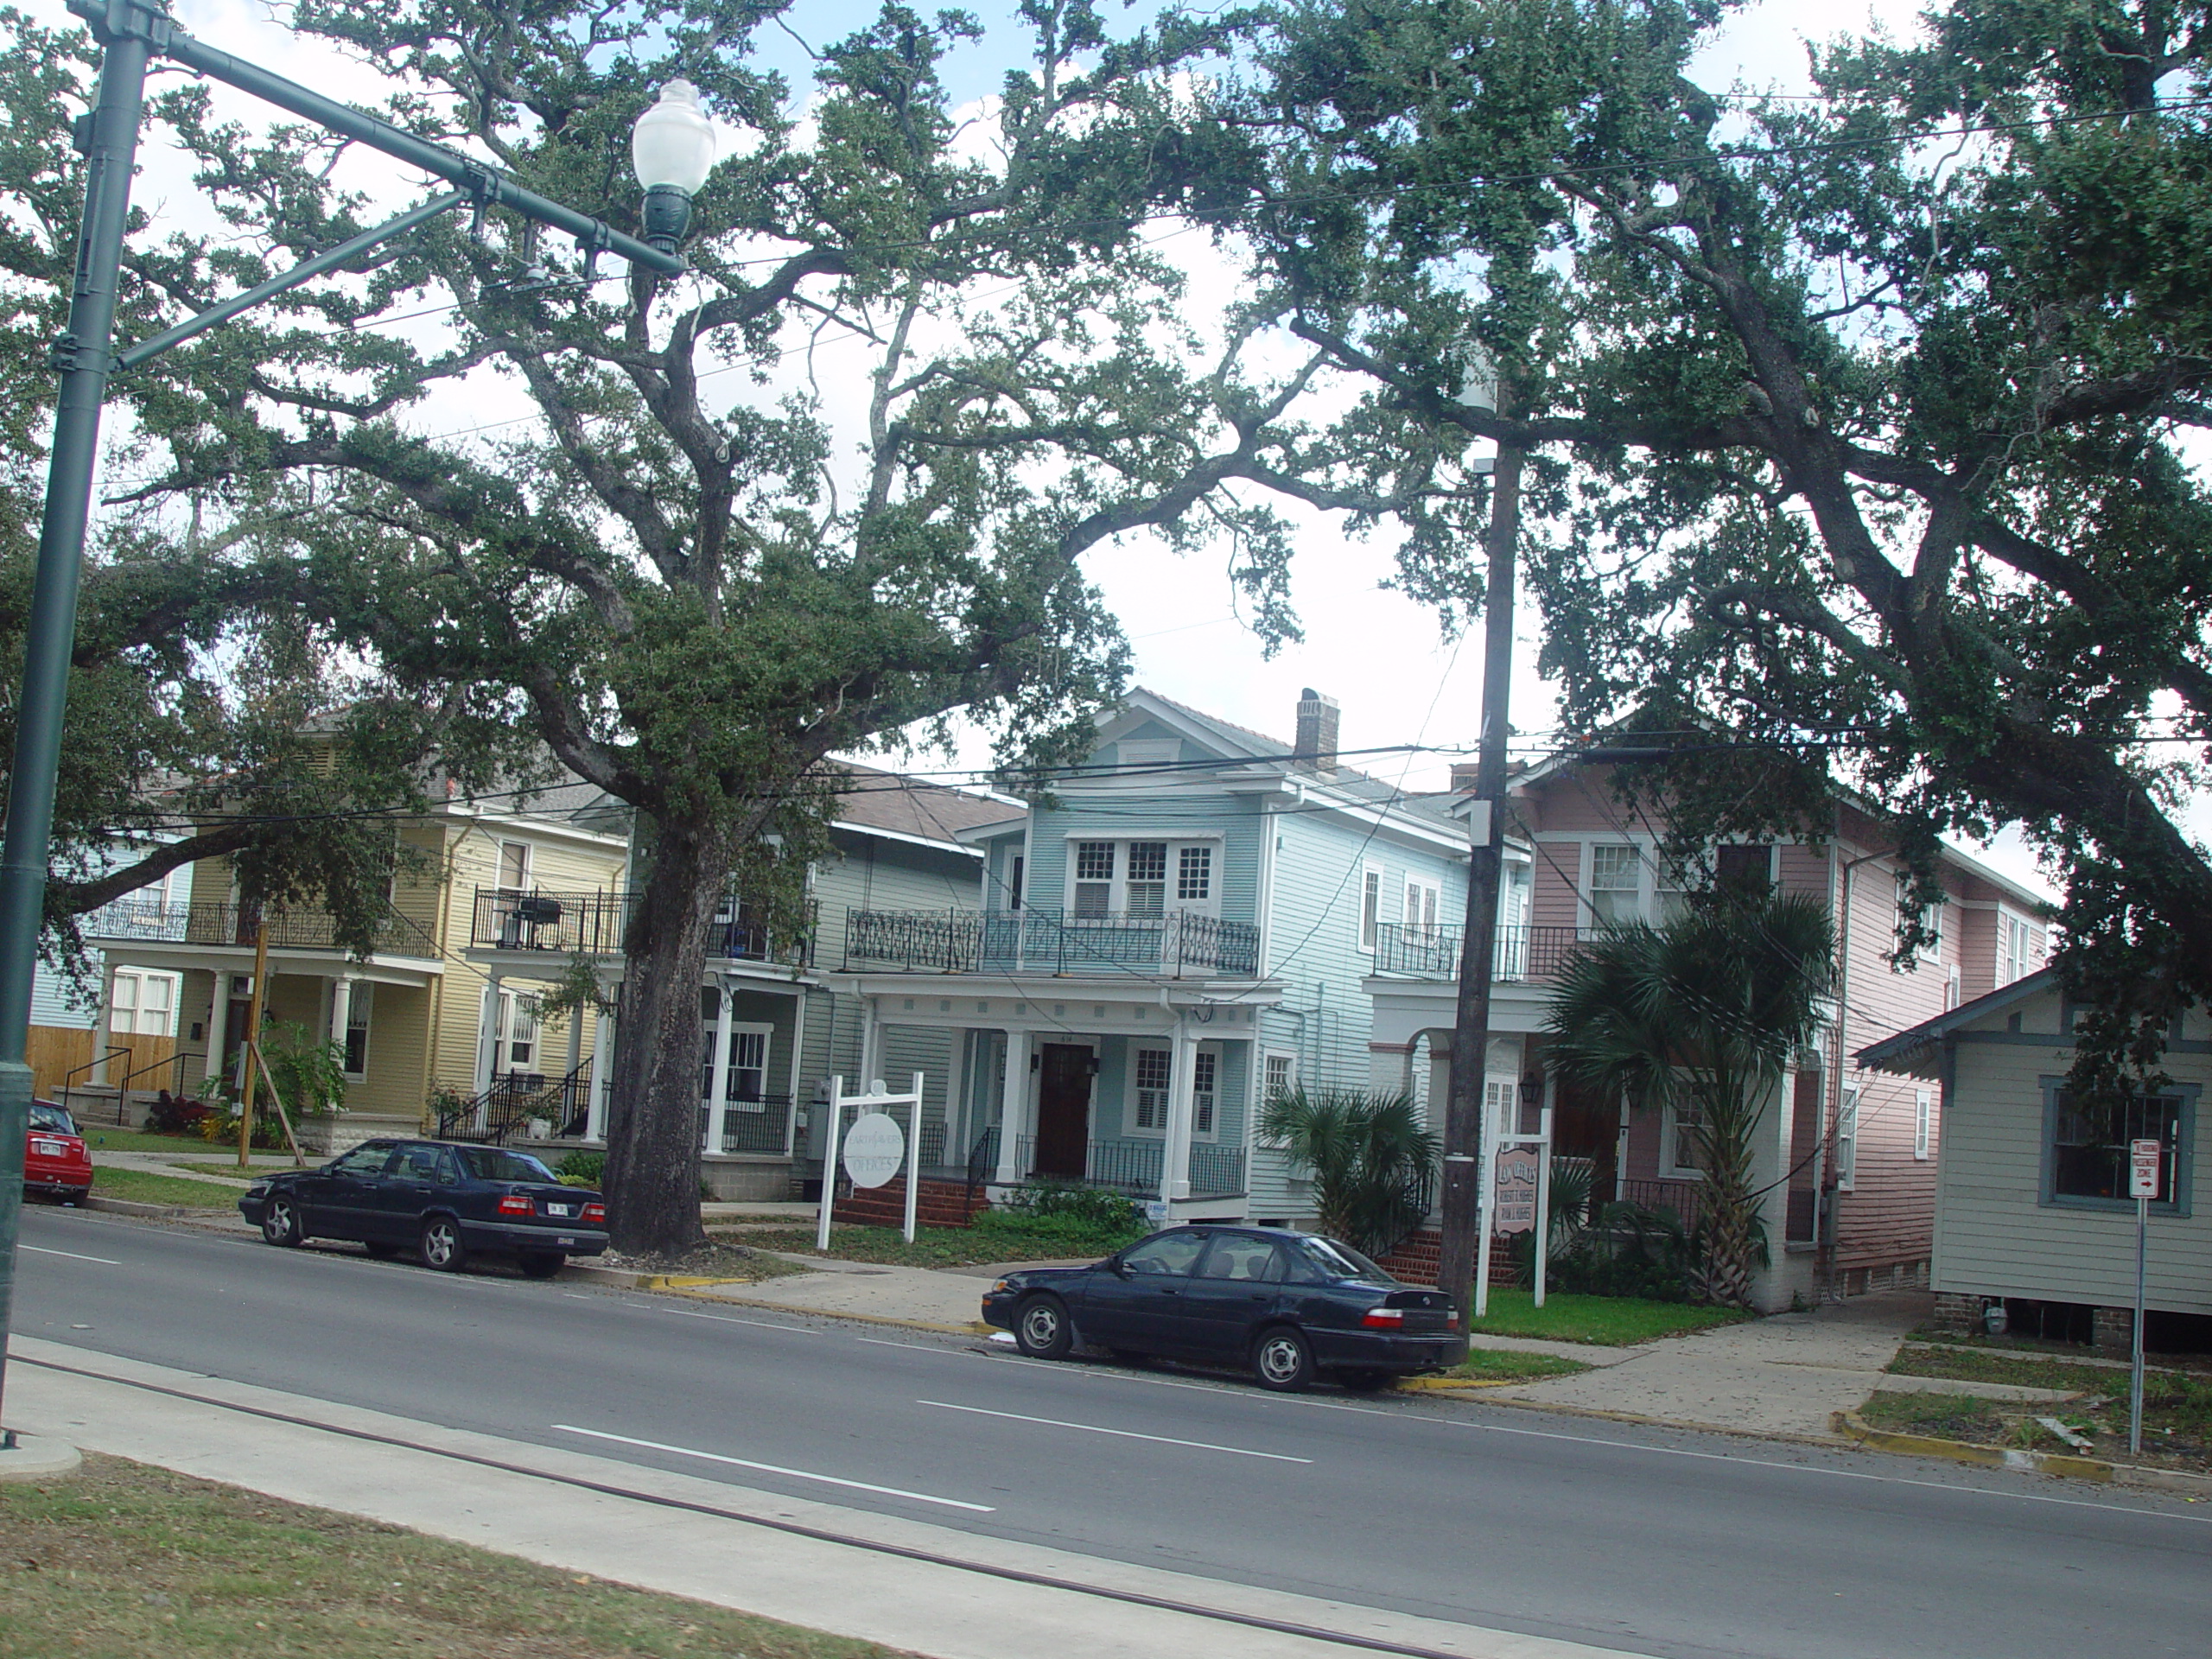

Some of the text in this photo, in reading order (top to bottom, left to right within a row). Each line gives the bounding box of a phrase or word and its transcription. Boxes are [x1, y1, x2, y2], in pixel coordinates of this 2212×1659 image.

[853, 1159, 893, 1172] OFFICES
[1498, 1160, 1536, 1185] LAW OFFICES
[2137, 1168, 2152, 1178] ZONE
